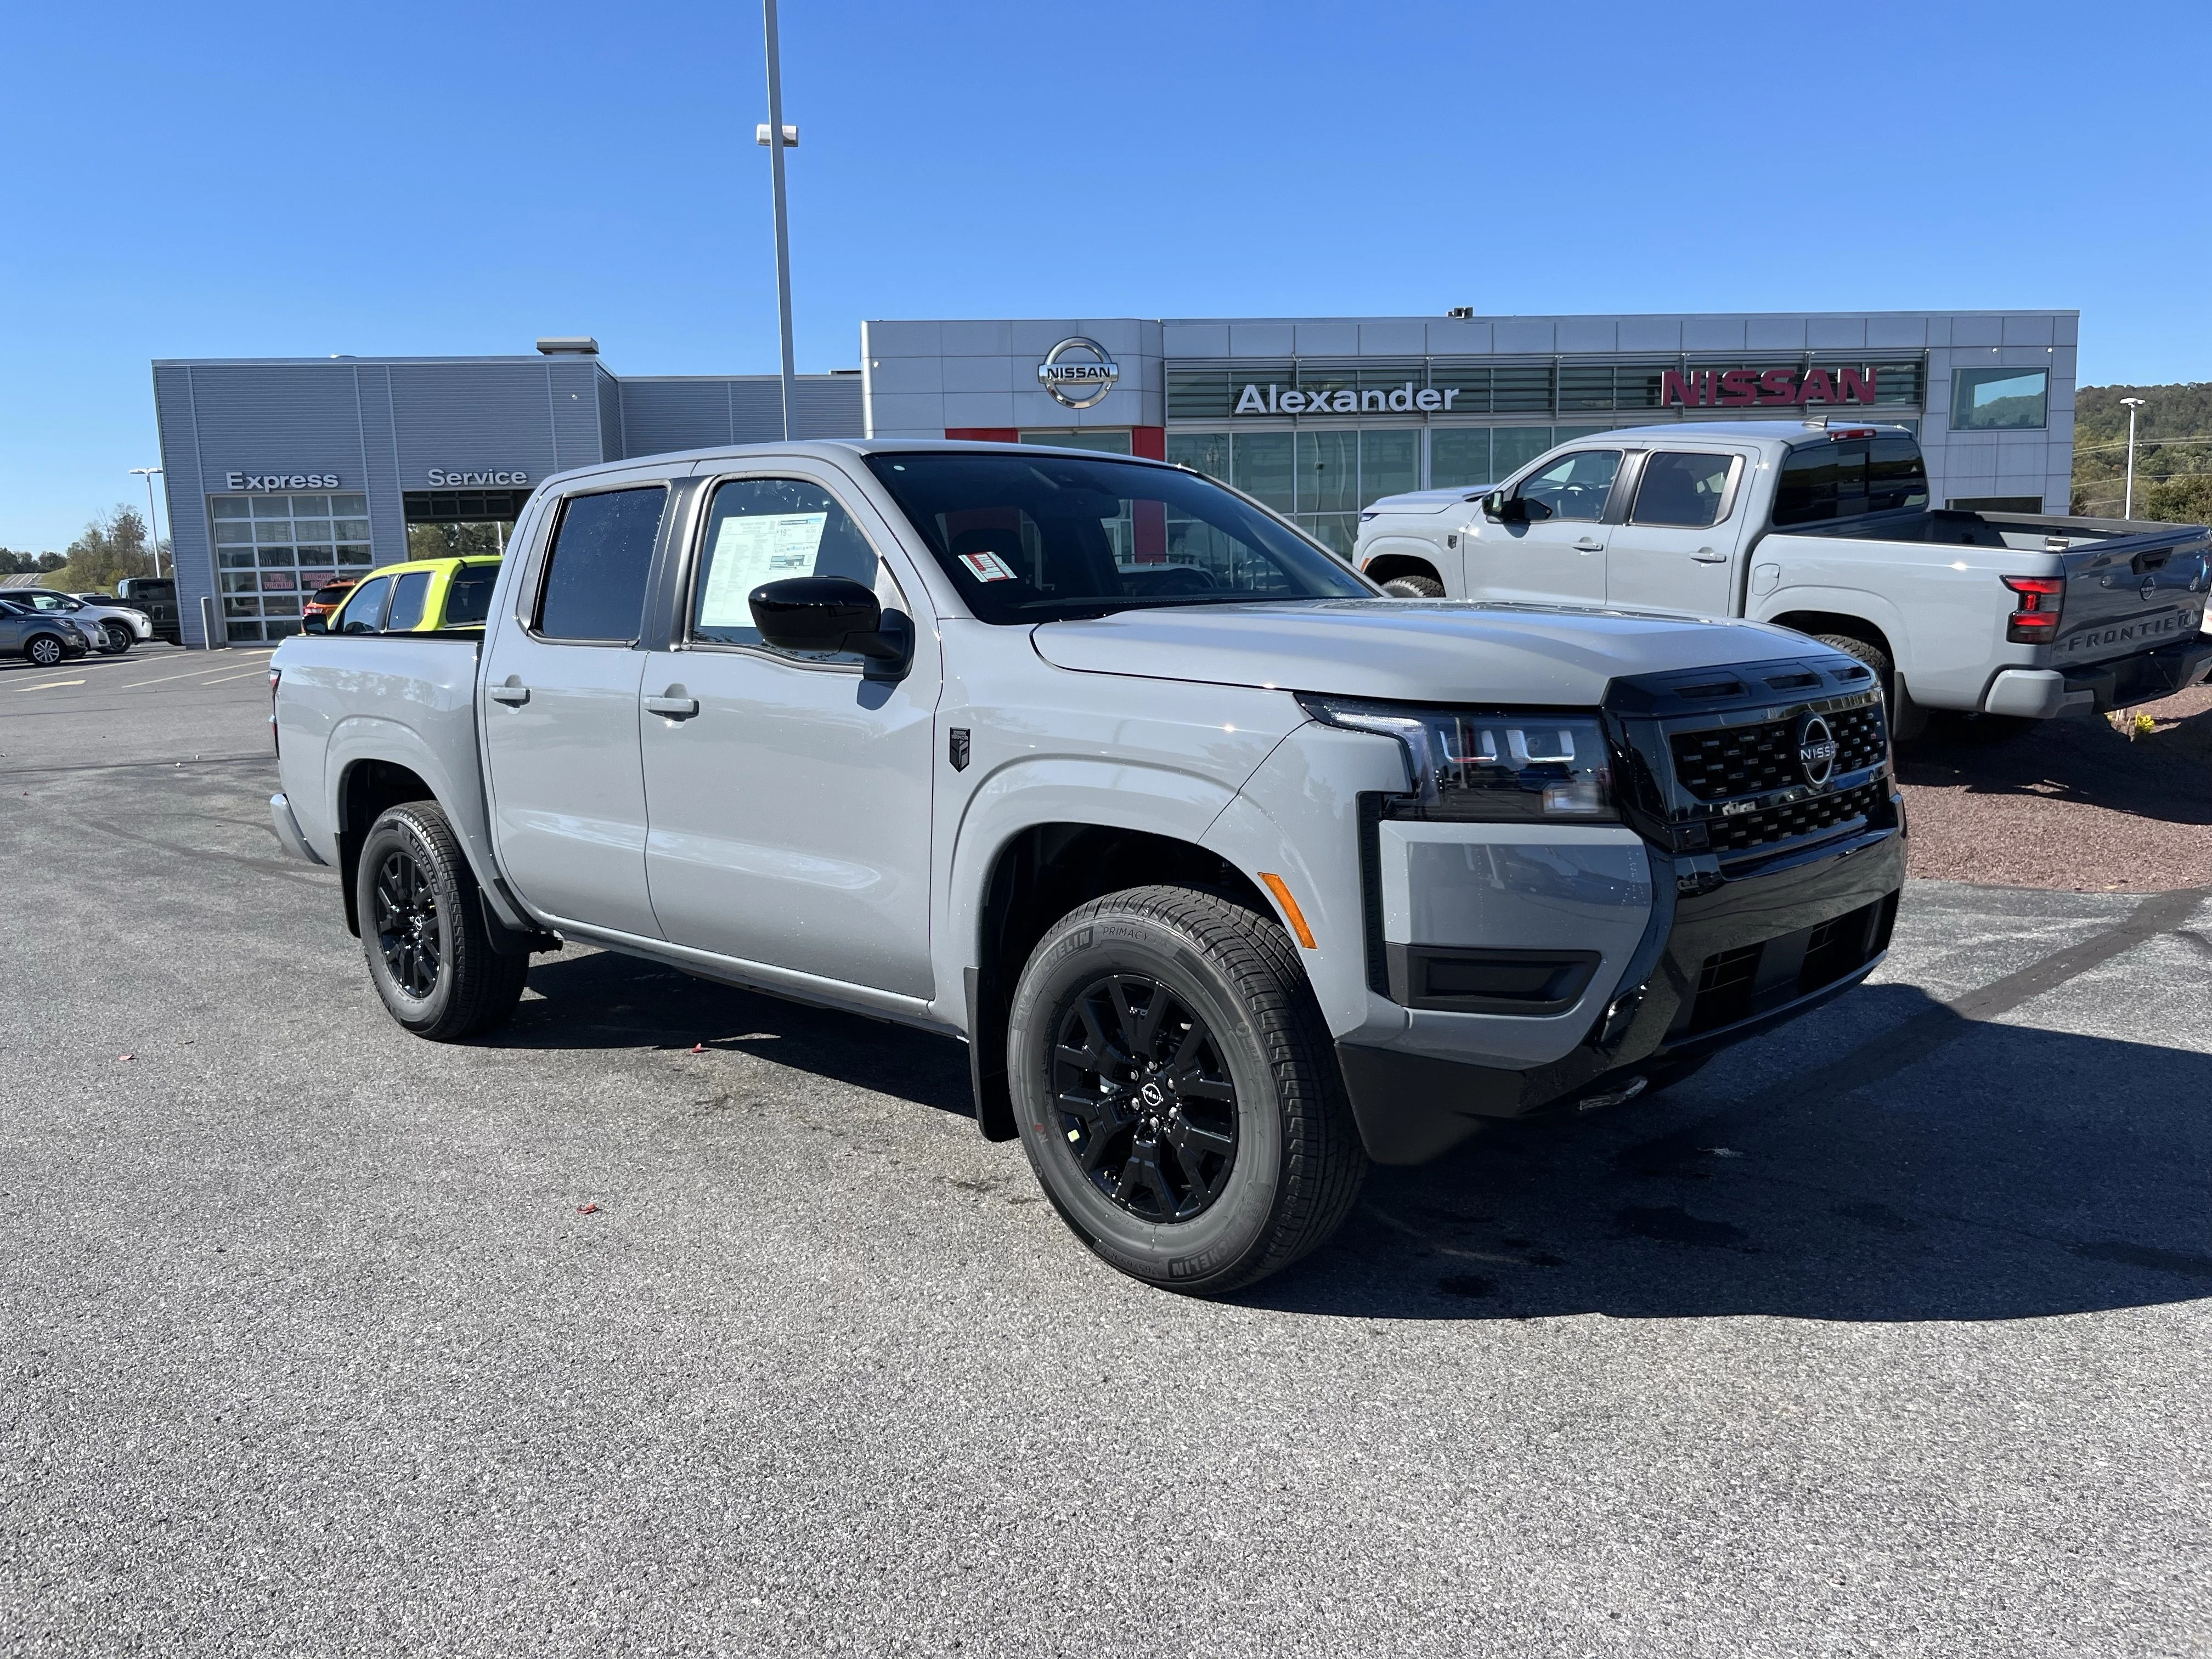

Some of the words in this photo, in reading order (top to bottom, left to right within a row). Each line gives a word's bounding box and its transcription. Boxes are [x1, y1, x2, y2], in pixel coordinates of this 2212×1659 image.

[1047, 366, 1110, 379] NISSAN
[1661, 368, 1877, 406] NISSAN
[1234, 382, 1459, 414] Alexander
[226, 472, 339, 493] Express
[428, 469, 527, 487] Service
[270, 573, 287, 582] PULL
[2069, 612, 2190, 651] FRONTIER
[1800, 742, 1835, 760] NISS
[1102, 927, 1150, 941] PRIMACY
